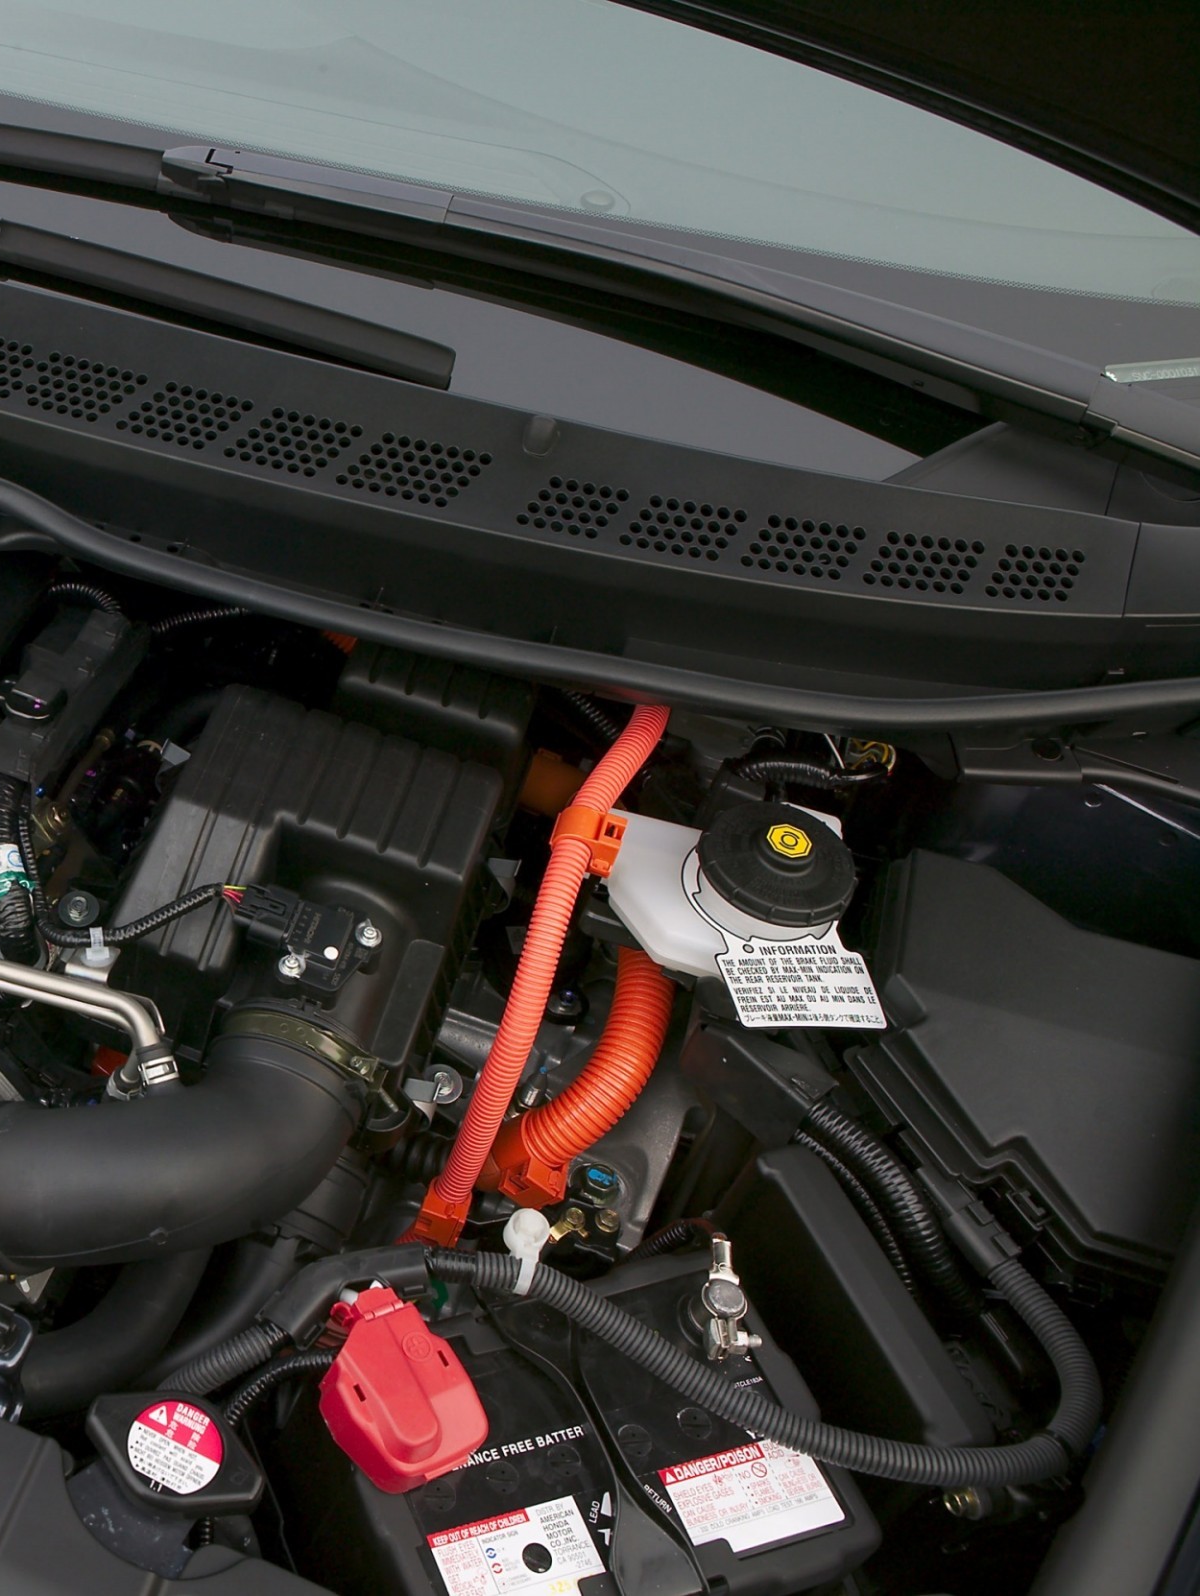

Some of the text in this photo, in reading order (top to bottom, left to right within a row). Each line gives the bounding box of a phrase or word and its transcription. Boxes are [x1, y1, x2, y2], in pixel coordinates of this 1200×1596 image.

[760, 945, 836, 955] INFORMATION
[723, 956, 862, 967] THE AMOUNT OF THE BRAKE FLUID SHALL
[727, 966, 864, 975] BE CHECKED BY MAX-MIN INDICATION ON
[729, 976, 743, 984] THE
[746, 976, 765, 984] REAR
[767, 975, 803, 984] RESERVOIR
[768, 986, 776, 994] SI
[779, 986, 789, 994] LE
[792, 986, 817, 994] NIVEAU
[821, 986, 831, 994] DE
[834, 986, 859, 994] LIQUIDE
[864, 987, 873, 995] DE
[737, 996, 757, 1004] FREIN
[761, 995, 773, 1003] EST
[777, 995, 786, 1003] AU
[789, 995, 804, 1003] MAX
[820, 995, 830, 1003] AU
[833, 995, 845, 1003] MIN
[848, 995, 865, 1003] DANS
[867, 996, 876, 1004] LE
[176, 1403, 210, 1427] DANGER
[172, 1413, 206, 1435] WARNUNG
[501, 1439, 534, 1457] FREE
[768, 1449, 784, 1461] ACID
[674, 1445, 763, 1481] DANGER/POISON
[739, 1470, 751, 1480] NO
[149, 1480, 162, 1492] 1.1
[673, 1482, 714, 1499] SHIELD EYES
[643, 1484, 672, 1514] RETURN
[677, 1487, 734, 1511] EXPLOSIVE GASES
[556, 1503, 564, 1511] BY
[589, 1500, 600, 1523] LEAD
[683, 1504, 716, 1518] CAN CAUSE
[540, 1509, 574, 1524] AMERICAN
[687, 1502, 749, 1527] BLINDNESS OR INJURY
[432, 1514, 528, 1546] KEEP OUT OF REACH OF CHILDREN
[543, 1520, 570, 1532] HONDA
[546, 1528, 573, 1540] MOTOR
[437, 1541, 475, 1556] FLUSH EYES
[557, 1555, 568, 1564] CA
[444, 1558, 482, 1576] WITH WATER
[448, 1573, 459, 1583] GET
